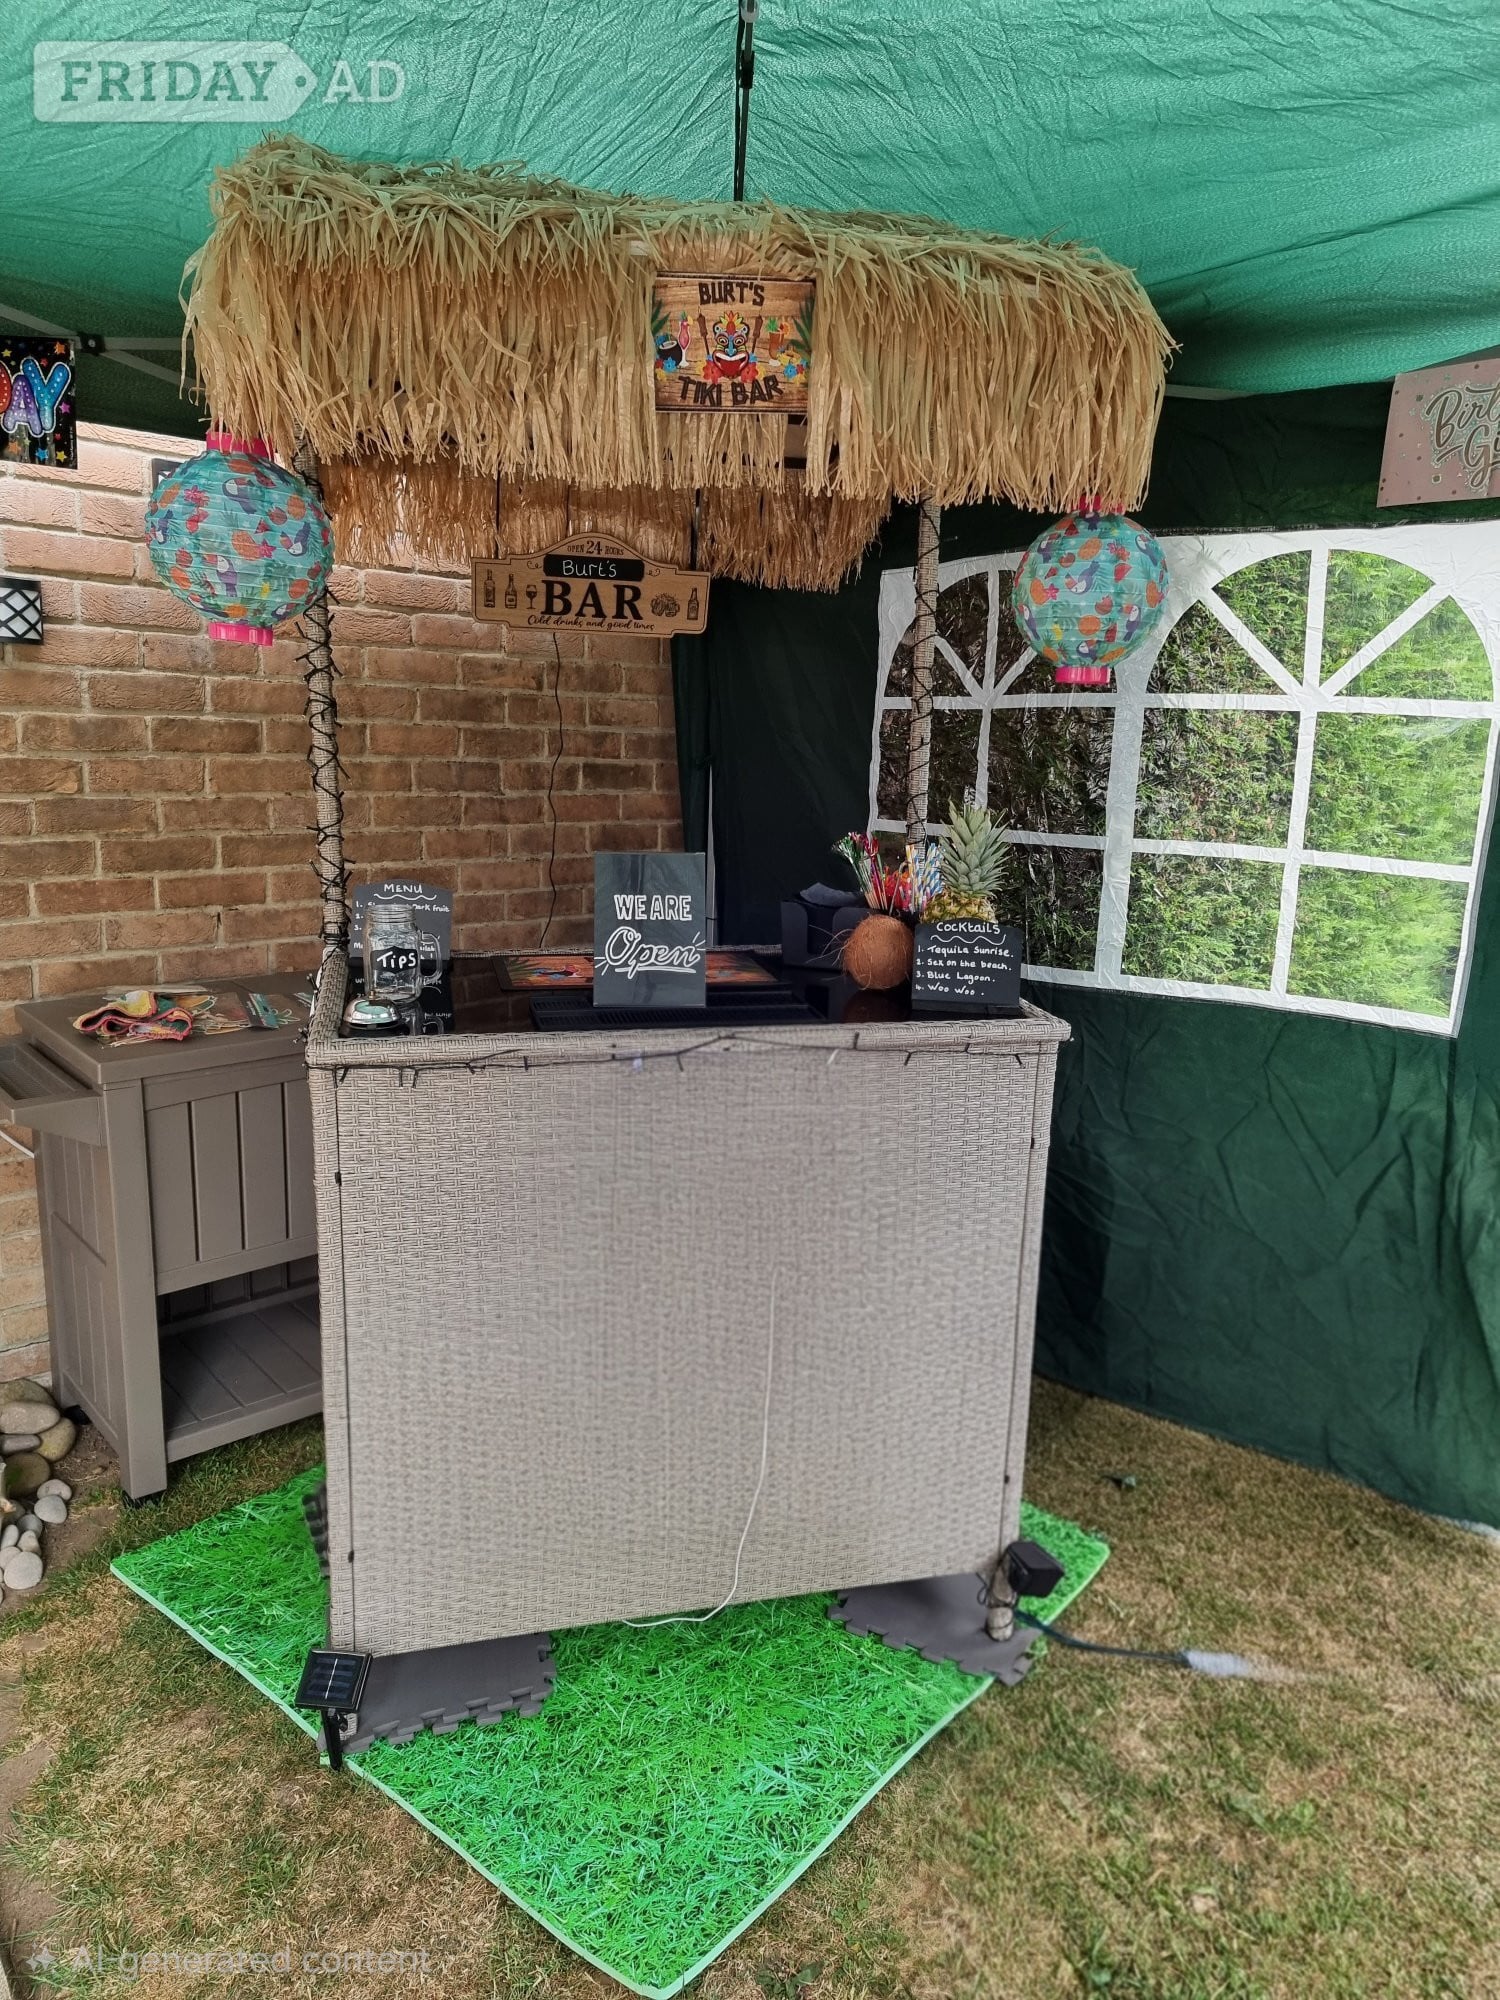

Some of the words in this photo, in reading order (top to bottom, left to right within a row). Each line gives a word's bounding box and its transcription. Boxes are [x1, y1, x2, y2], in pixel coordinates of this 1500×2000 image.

[698, 281, 765, 307] BURT'S
[0, 356, 71, 438] AY
[678, 375, 722, 407] TIKI
[731, 374, 784, 406] BAR
[1426, 379, 1500, 448] Birt
[567, 544, 585, 553] OPEN
[586, 540, 602, 555] 24
[562, 559, 617, 578] Burt's
[540, 579, 645, 621] BAR
[527, 614, 550, 626] Cold
[553, 615, 583, 627] drinks
[586, 617, 605, 628] and
[607, 619, 632, 631] good
[633, 620, 655, 631] times
[383, 883, 423, 894] MENU
[614, 894, 647, 920] WE
[649, 895, 692, 921] ARE
[605, 926, 701, 979] Open
[918, 945, 925, 953] 1.
[973, 946, 1014, 958] Sunrise.
[927, 959, 944, 967] Sex
[960, 959, 976, 968] the
[981, 959, 1012, 971] beach.
[916, 970, 925, 978] 3.
[927, 971, 951, 980] Blue
[956, 971, 996, 985] Lagoon.
[928, 982, 949, 993] Woo
